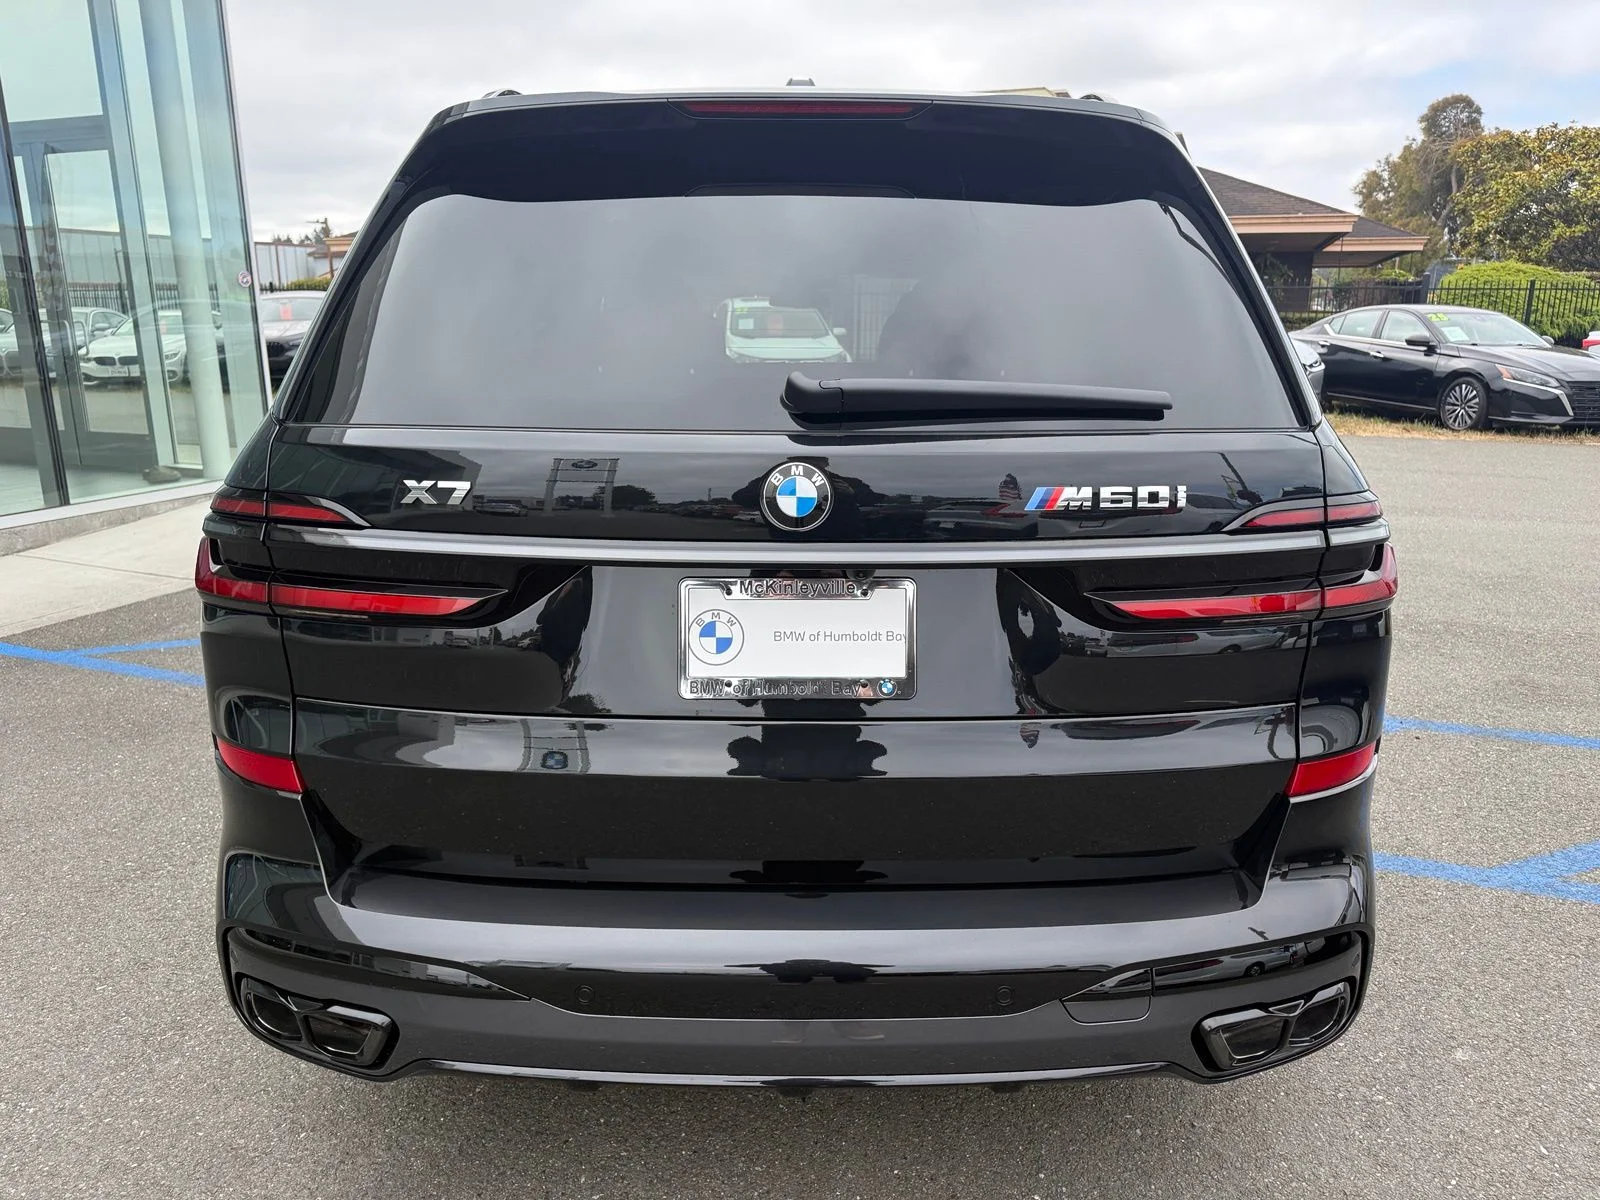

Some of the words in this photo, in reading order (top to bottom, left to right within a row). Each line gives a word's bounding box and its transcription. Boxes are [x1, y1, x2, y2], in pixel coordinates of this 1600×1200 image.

[770, 465, 825, 487] BMW
[400, 480, 471, 505] X7
[739, 580, 857, 598] McKinleyville
[695, 612, 737, 627] BMW
[773, 630, 806, 642] BMW
[808, 630, 821, 642] of
[823, 630, 883, 642] Humboldt
[689, 681, 725, 696] BMW
[733, 681, 750, 696] of
